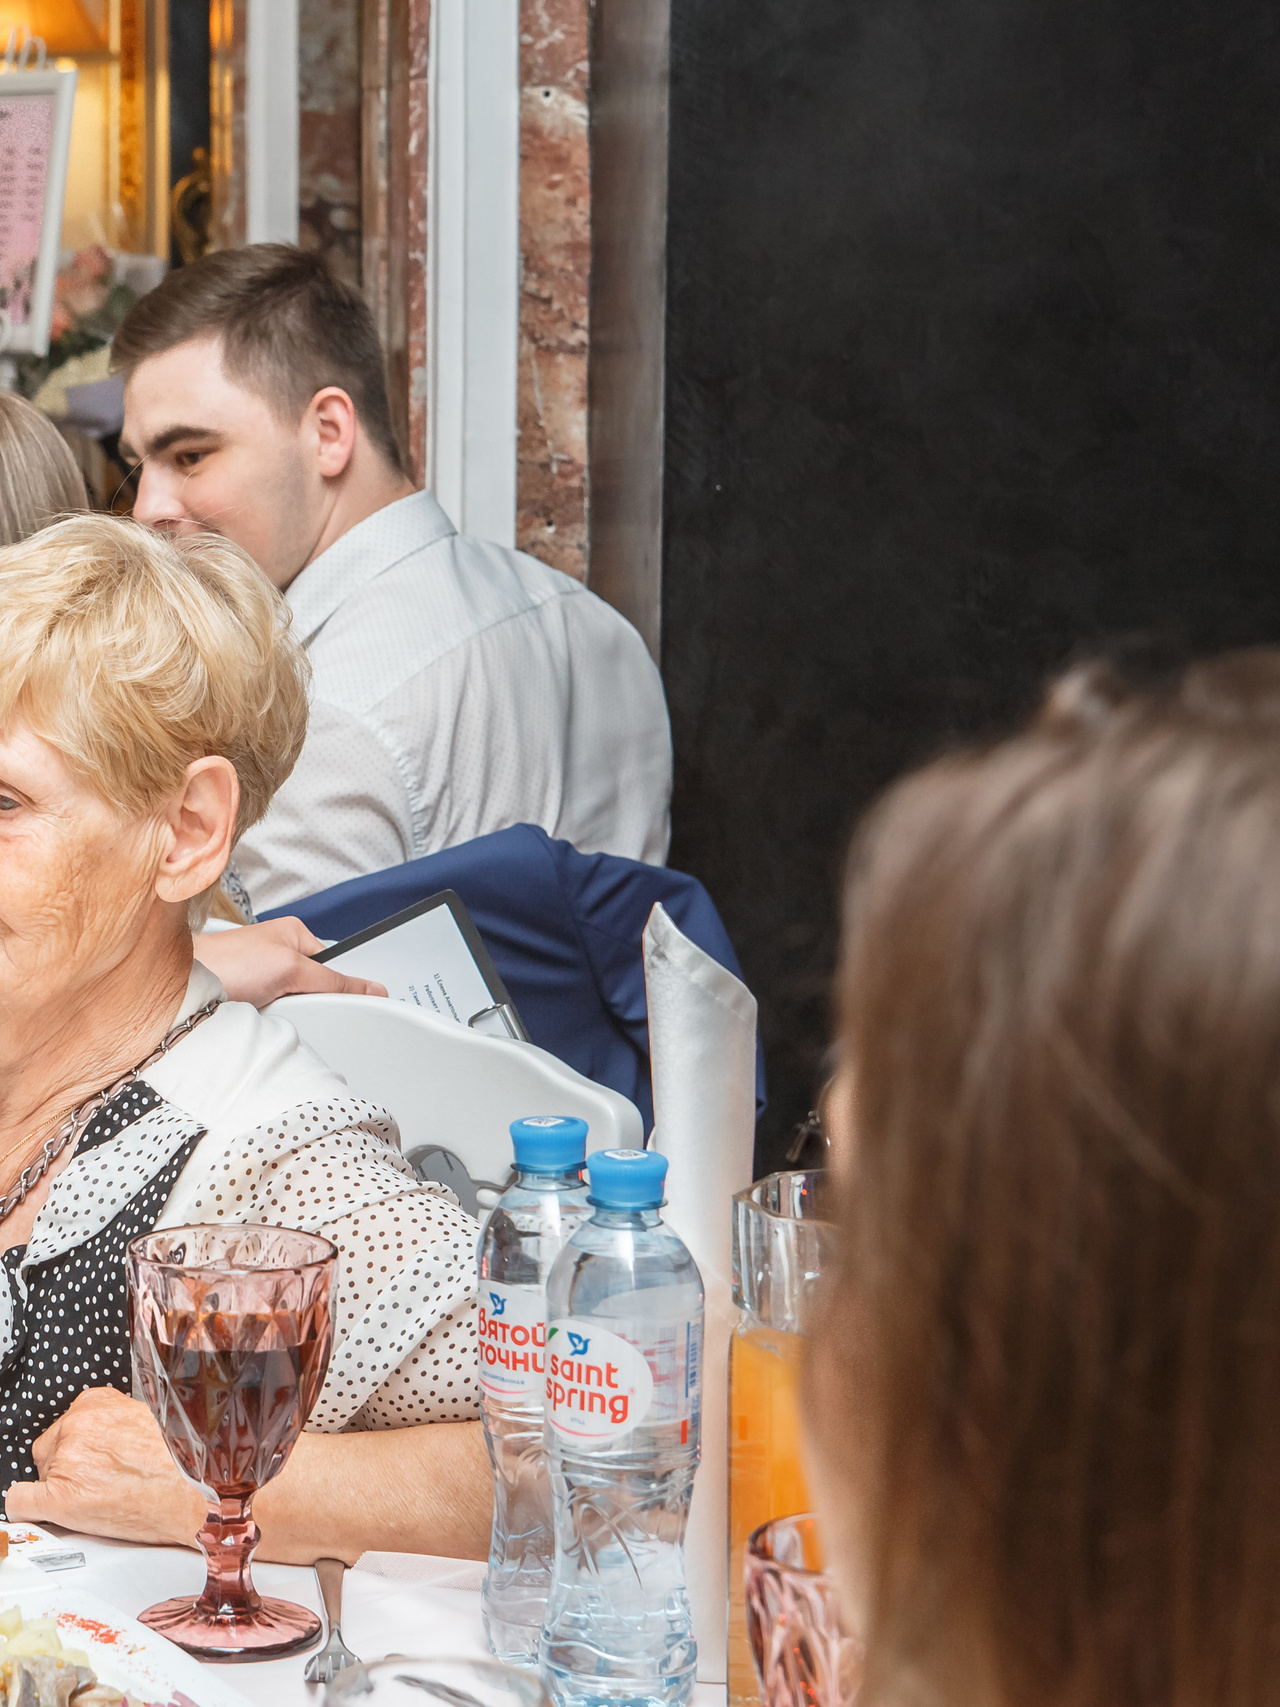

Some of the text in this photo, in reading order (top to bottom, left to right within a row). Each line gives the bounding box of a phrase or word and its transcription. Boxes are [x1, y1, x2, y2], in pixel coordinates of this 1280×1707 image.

[412, 991, 422, 1006] Тама
[424, 984, 438, 1009] Работает
[436, 979, 447, 996] Елена
[550, 1354, 618, 1388] saint
[546, 1377, 629, 1424] spring
